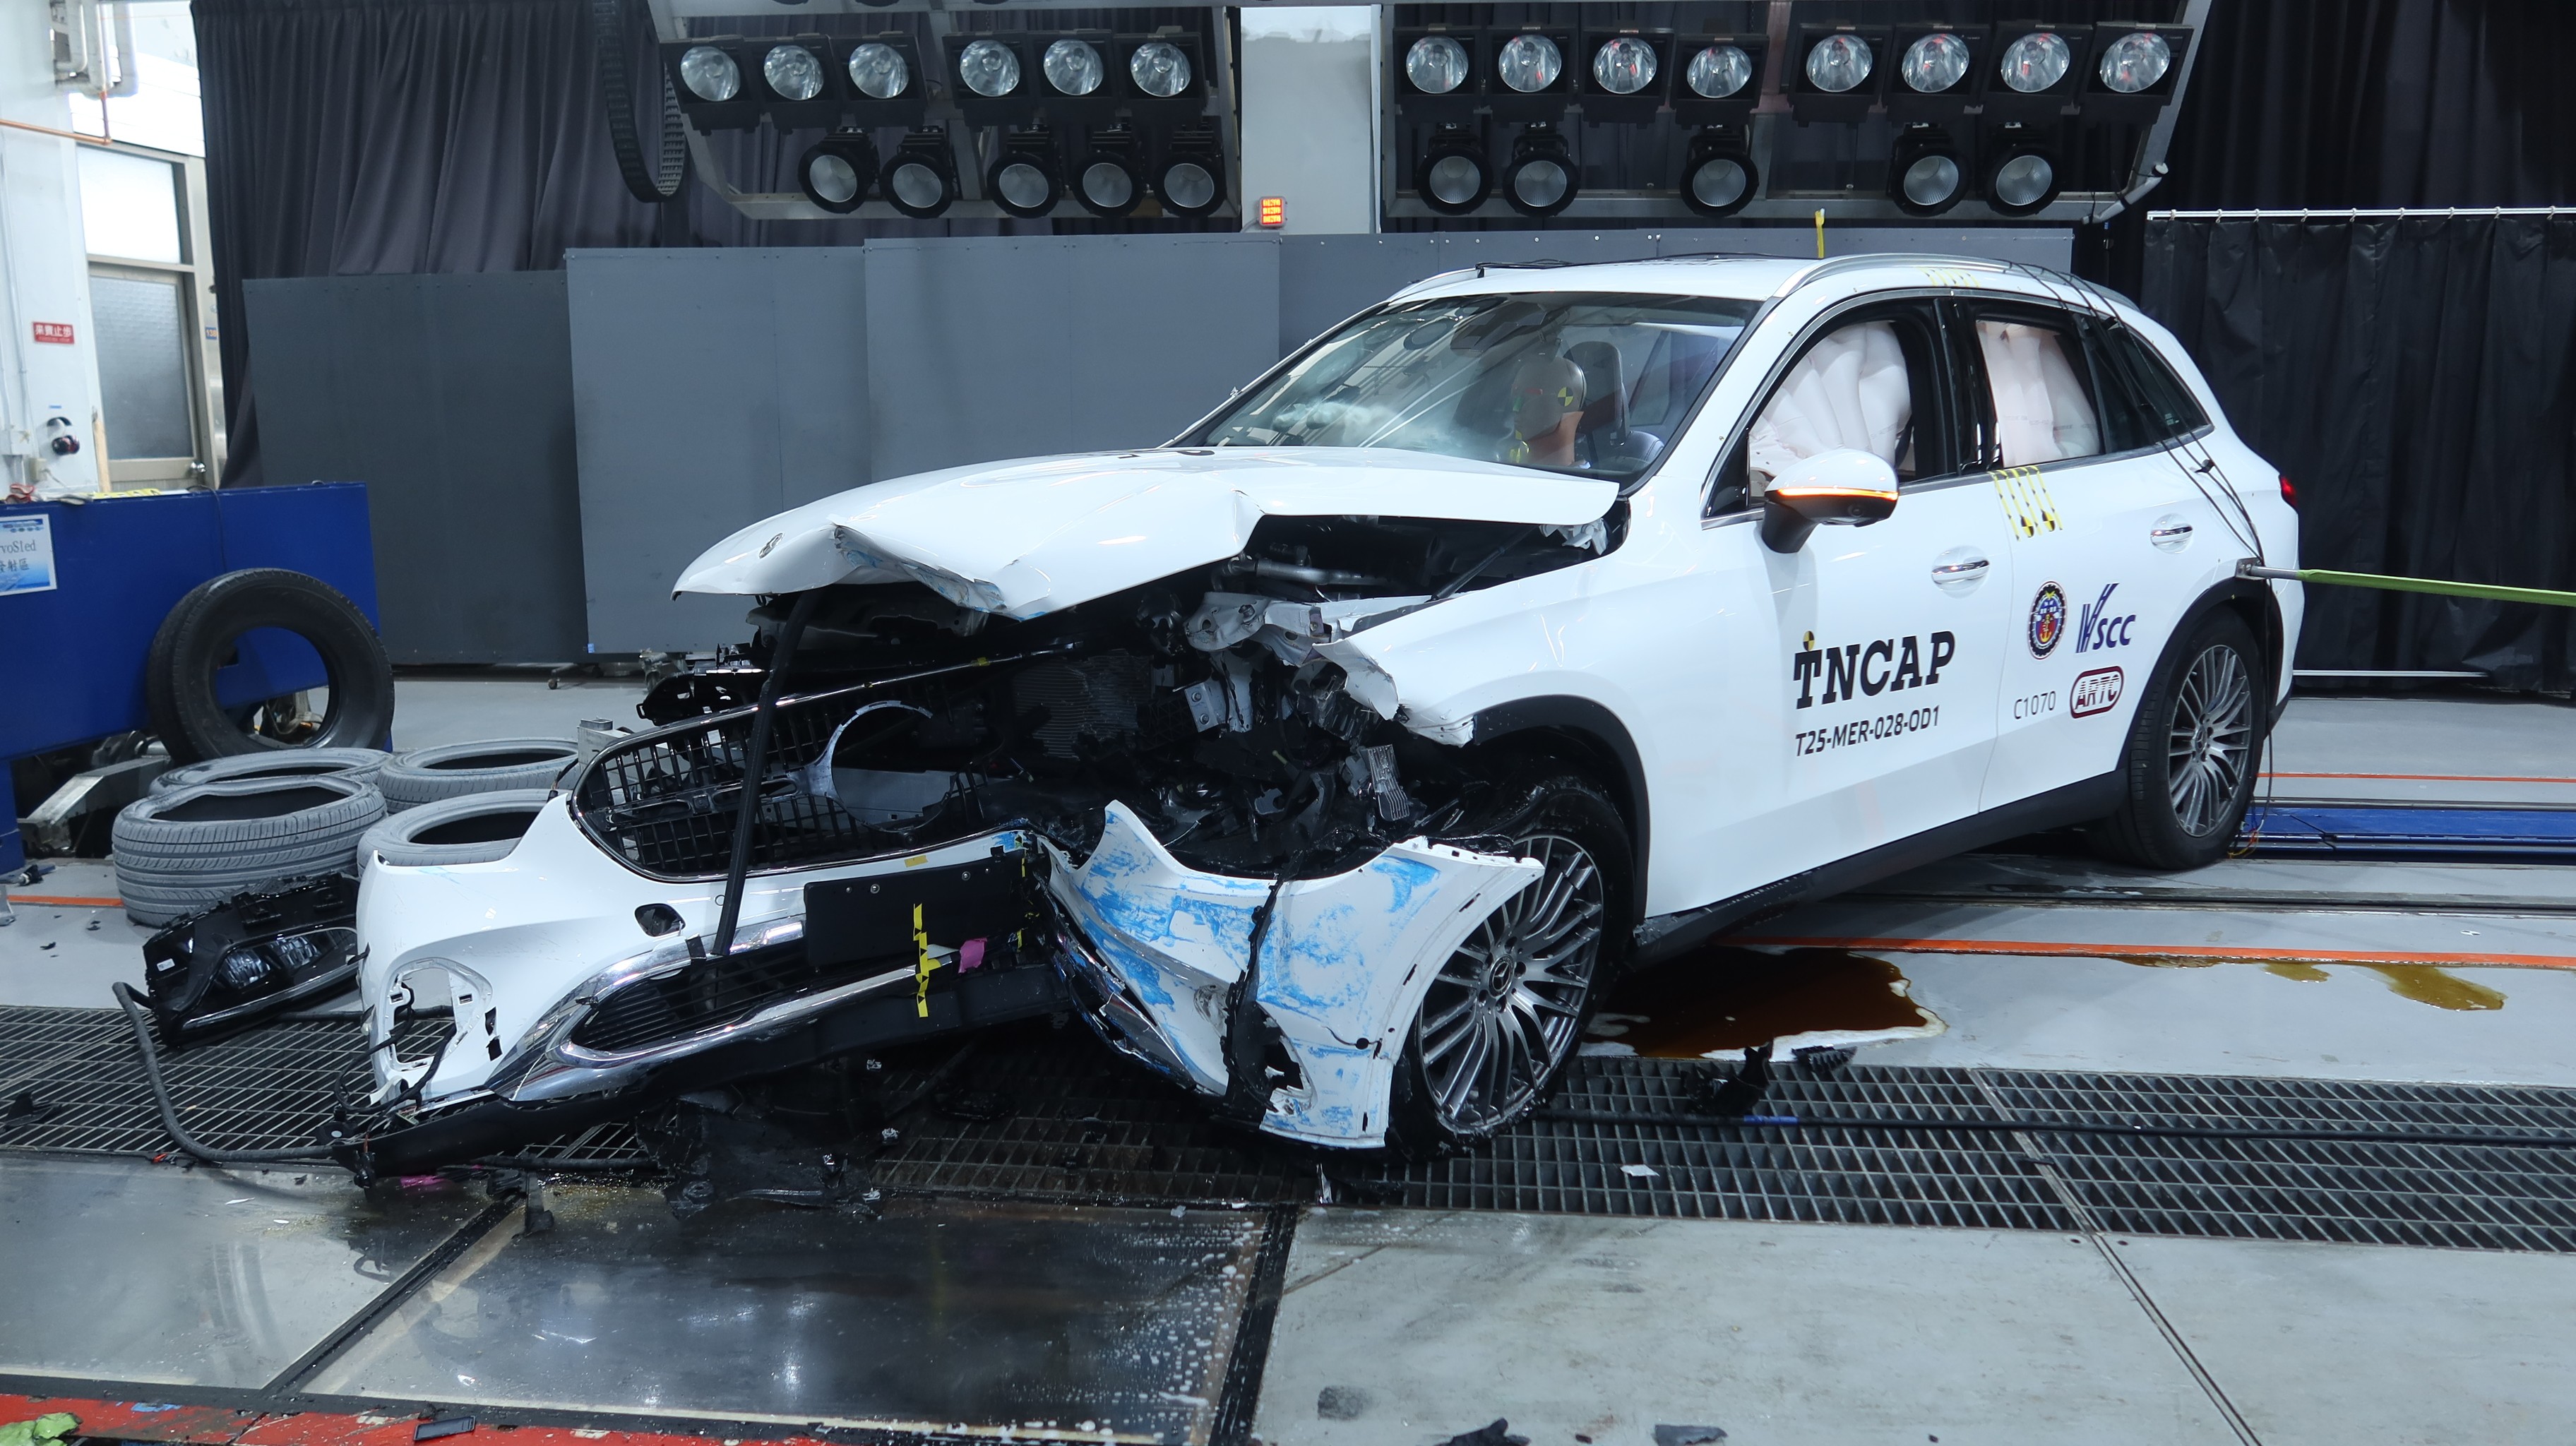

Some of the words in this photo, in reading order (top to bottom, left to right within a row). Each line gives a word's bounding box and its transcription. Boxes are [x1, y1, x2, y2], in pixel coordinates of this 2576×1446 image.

[0, 539, 36, 554] voSled
[1794, 631, 1955, 710] TNCAP
[2014, 691, 2057, 719] C1070
[2074, 674, 2121, 710] ARTC
[1795, 705, 1940, 757] T25-MER-028-OD1
